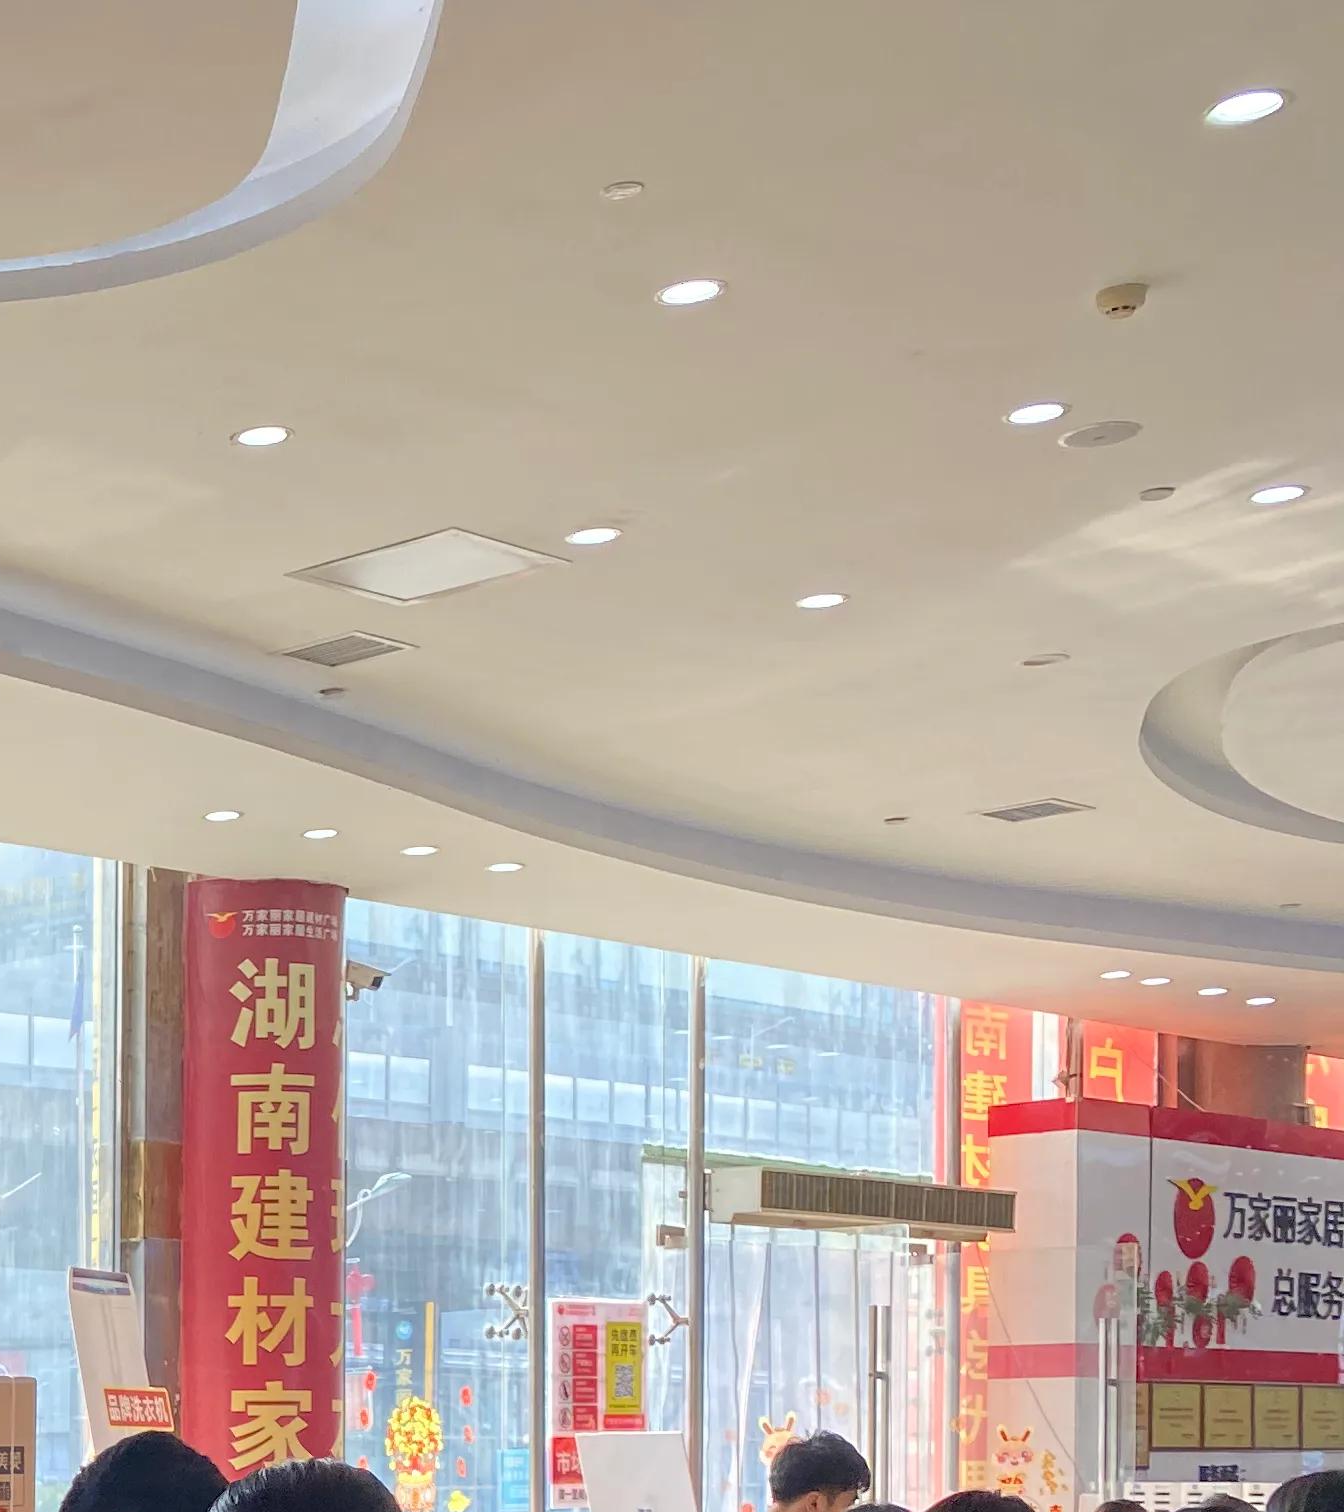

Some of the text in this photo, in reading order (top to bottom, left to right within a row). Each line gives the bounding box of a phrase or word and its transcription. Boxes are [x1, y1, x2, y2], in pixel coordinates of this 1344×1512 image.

[225, 957, 317, 1478] 湖南建材家
[1223, 1191, 1344, 1248] 万家丽家居
[106, 1393, 169, 1423] 品牌洗衣机
